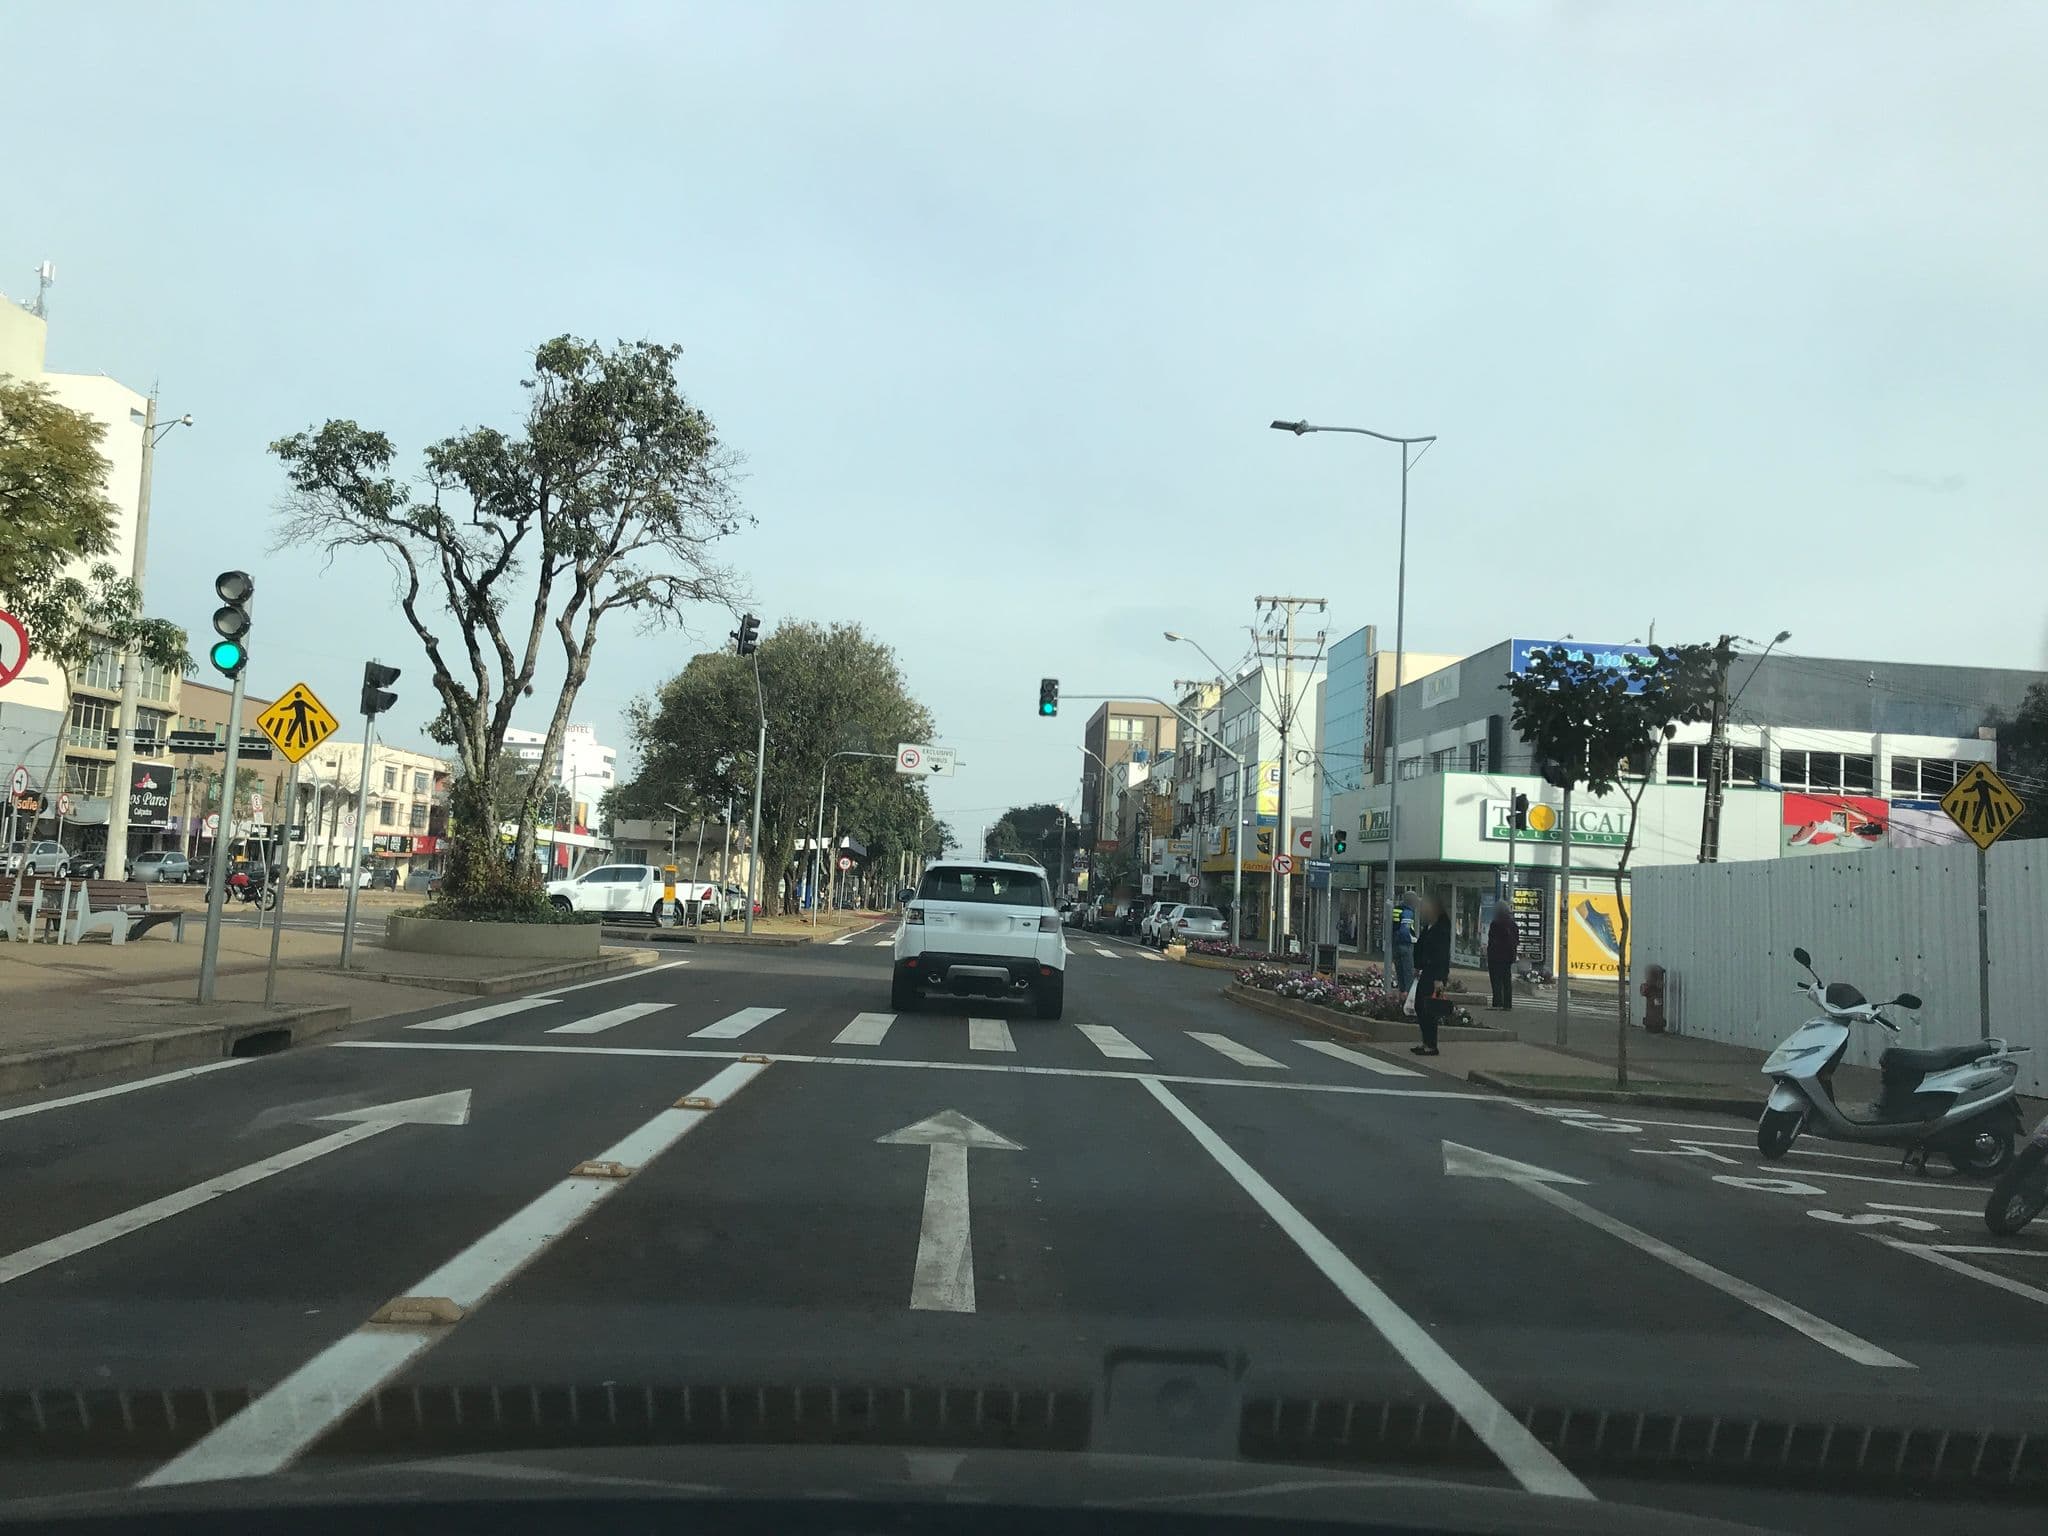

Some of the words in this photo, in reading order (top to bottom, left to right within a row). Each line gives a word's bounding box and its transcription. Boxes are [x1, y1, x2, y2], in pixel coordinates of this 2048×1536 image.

[566, 724, 590, 734] HOTEL
[922, 748, 954, 757] EXCLUSIVO
[142, 791, 169, 807] Pares
[1570, 961, 1598, 971] WEST
[1599, 963, 1631, 973] COAT
